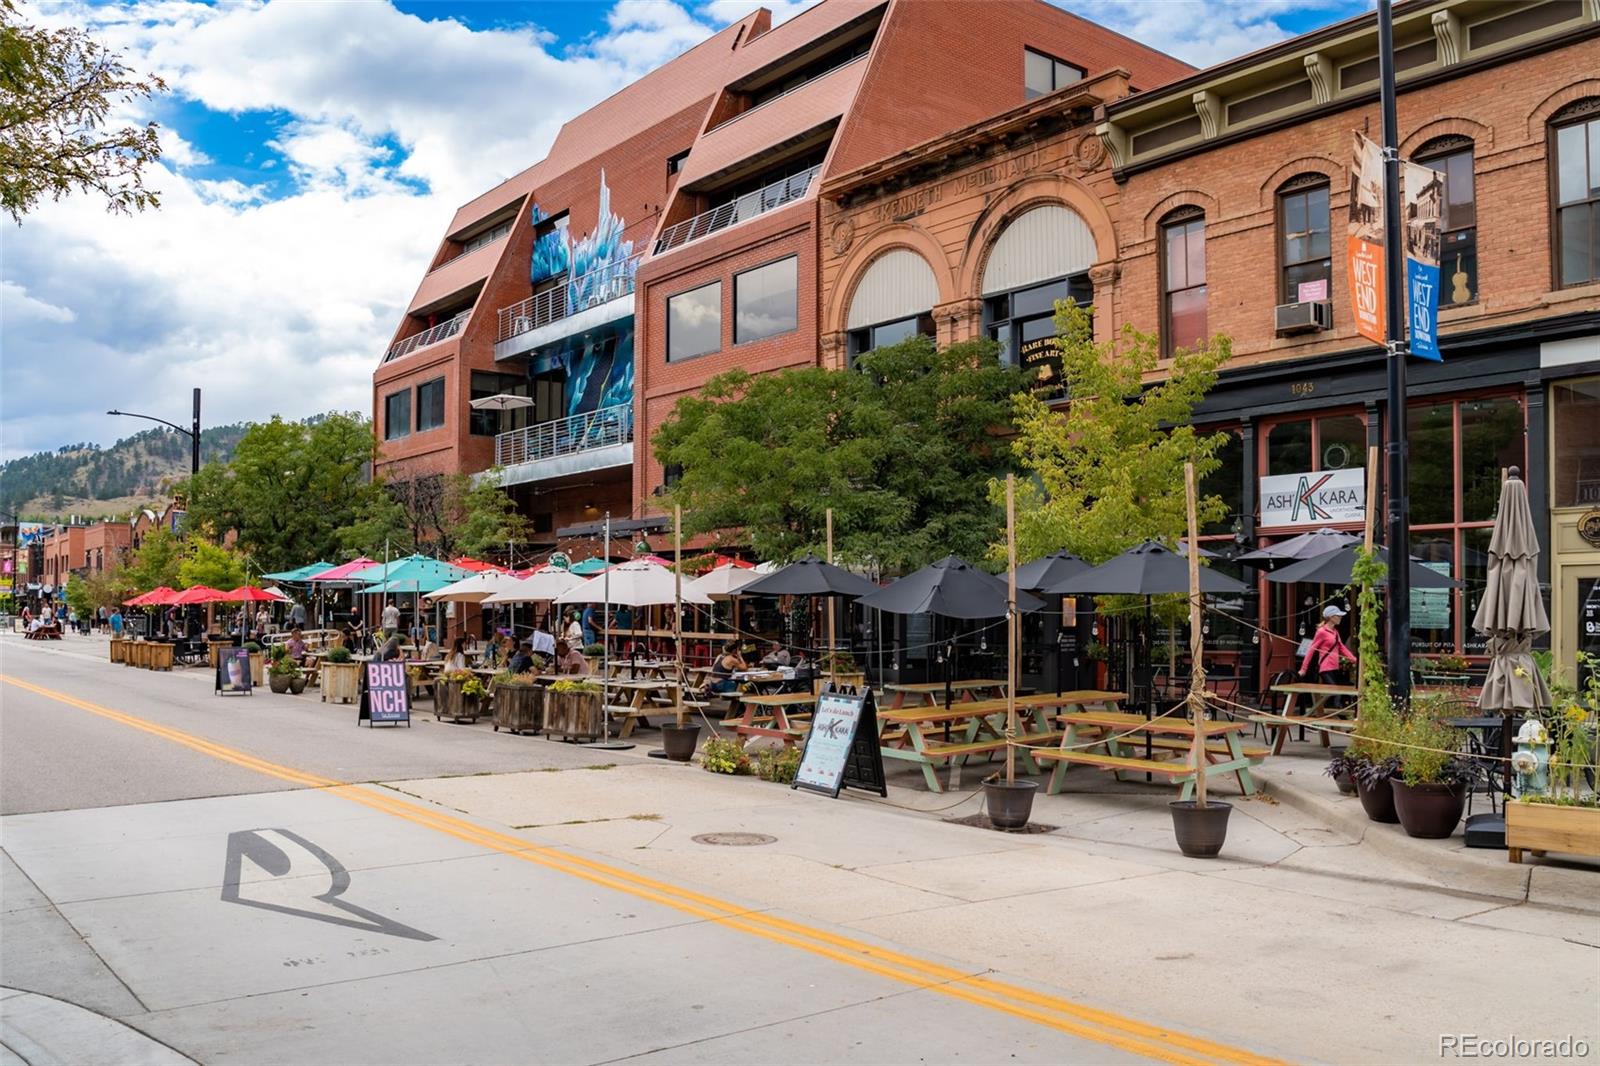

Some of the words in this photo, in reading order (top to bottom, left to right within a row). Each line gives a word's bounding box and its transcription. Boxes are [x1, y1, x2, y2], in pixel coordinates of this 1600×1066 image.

[878, 185, 942, 222] KENNETH
[1352, 256, 1378, 288] WEST
[1355, 282, 1377, 314] END
[1413, 279, 1433, 307] WEST
[1413, 303, 1430, 333] END
[1319, 489, 1358, 505] KARA
[368, 663, 405, 687] BRU
[369, 690, 407, 713] NCH
